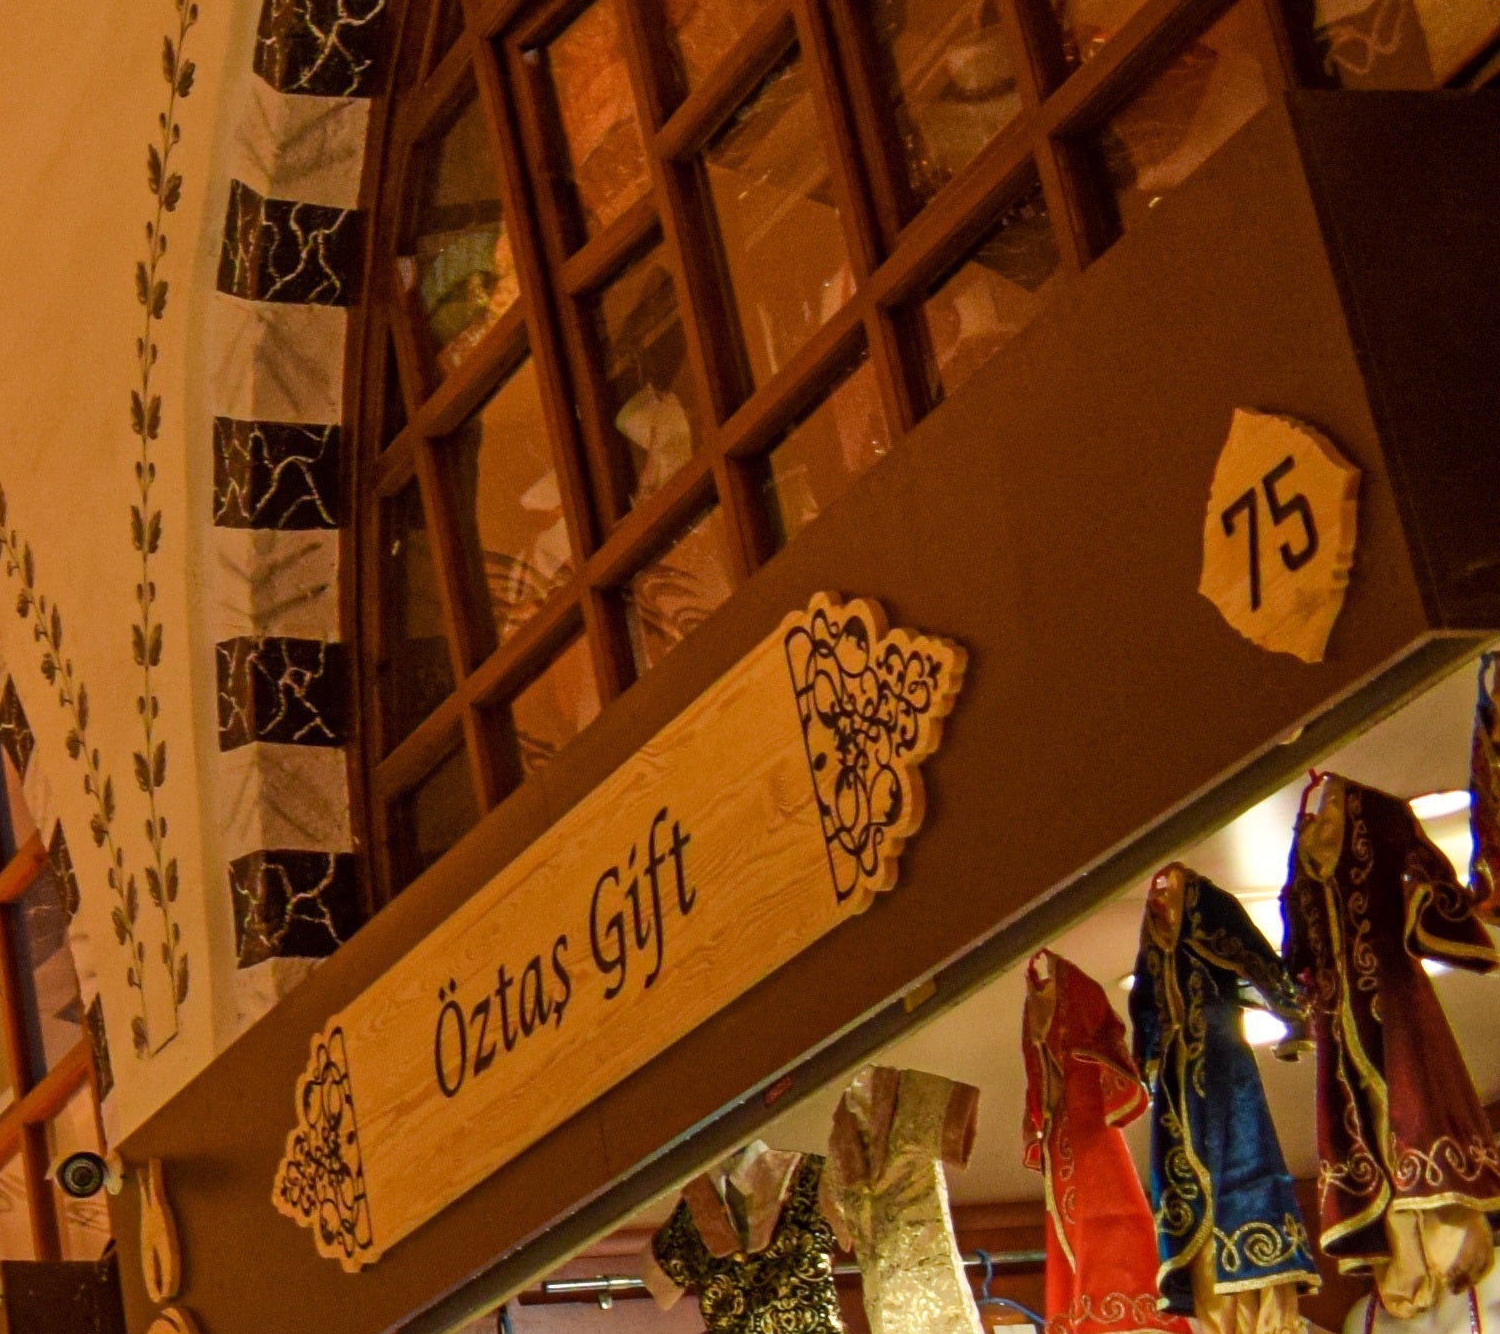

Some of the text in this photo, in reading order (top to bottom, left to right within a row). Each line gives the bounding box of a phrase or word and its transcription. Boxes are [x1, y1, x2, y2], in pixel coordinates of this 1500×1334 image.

[1220, 455, 1319, 612] 75
[434, 806, 696, 1098] Öztaş Gift
